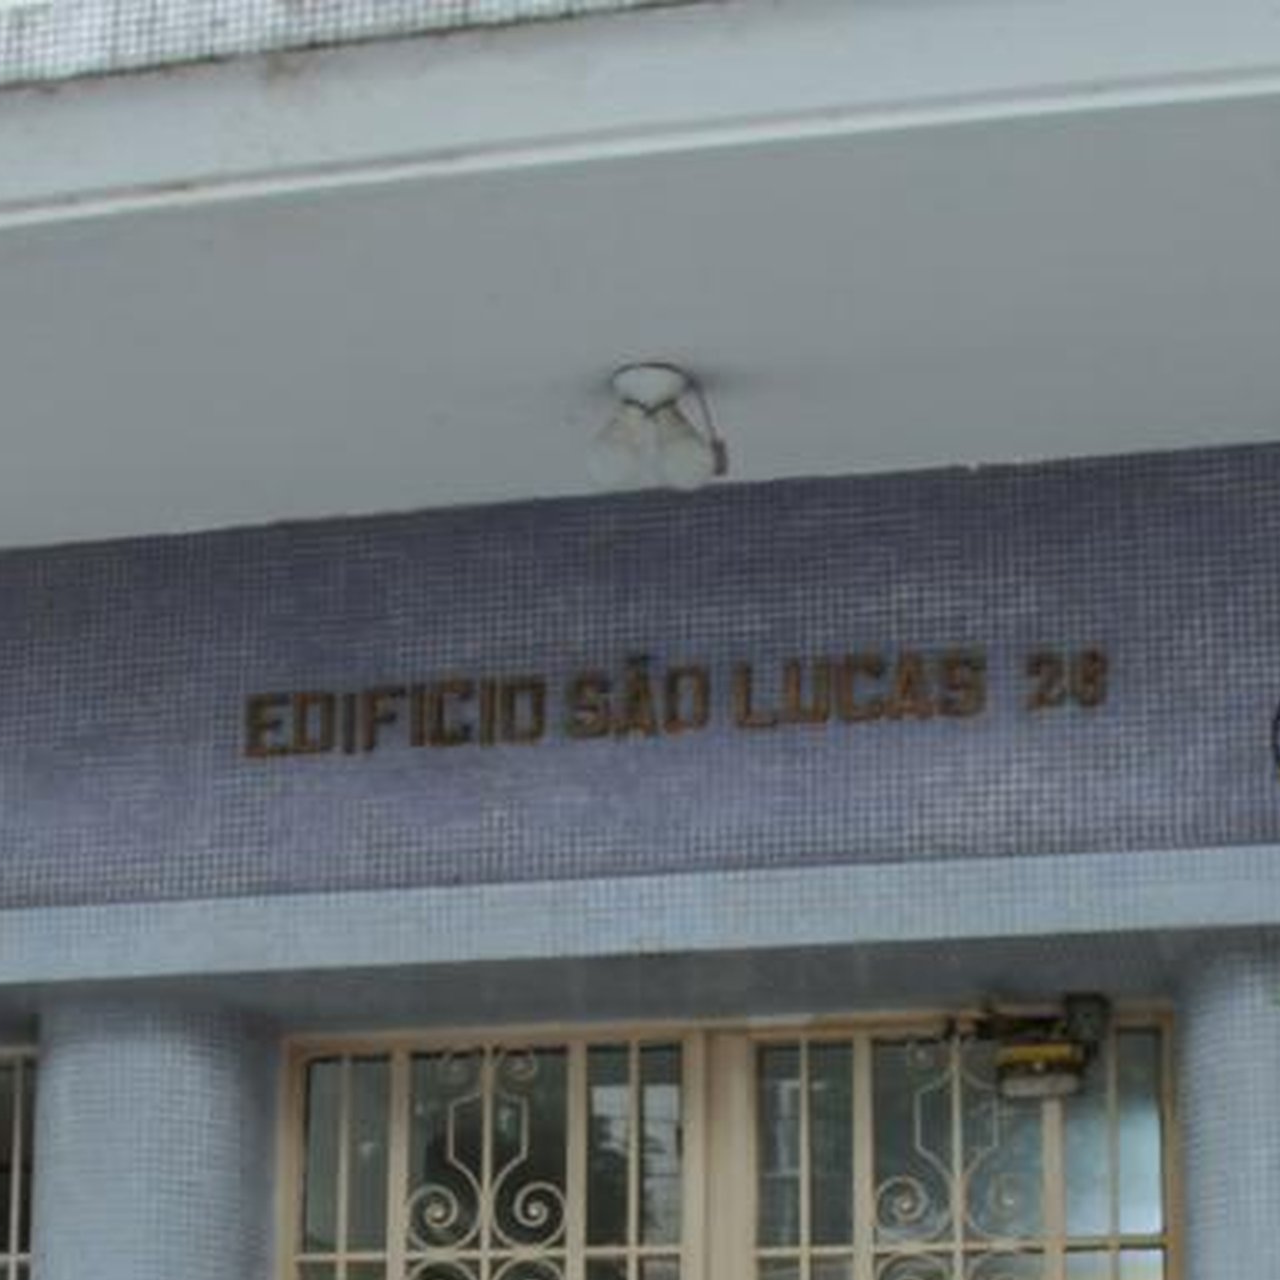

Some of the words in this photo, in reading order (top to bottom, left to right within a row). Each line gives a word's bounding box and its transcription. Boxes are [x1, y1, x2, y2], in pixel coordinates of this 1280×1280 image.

[245, 674, 546, 758] EDIFICIO
[564, 653, 710, 740] SÃO
[733, 648, 987, 729] LUCAS
